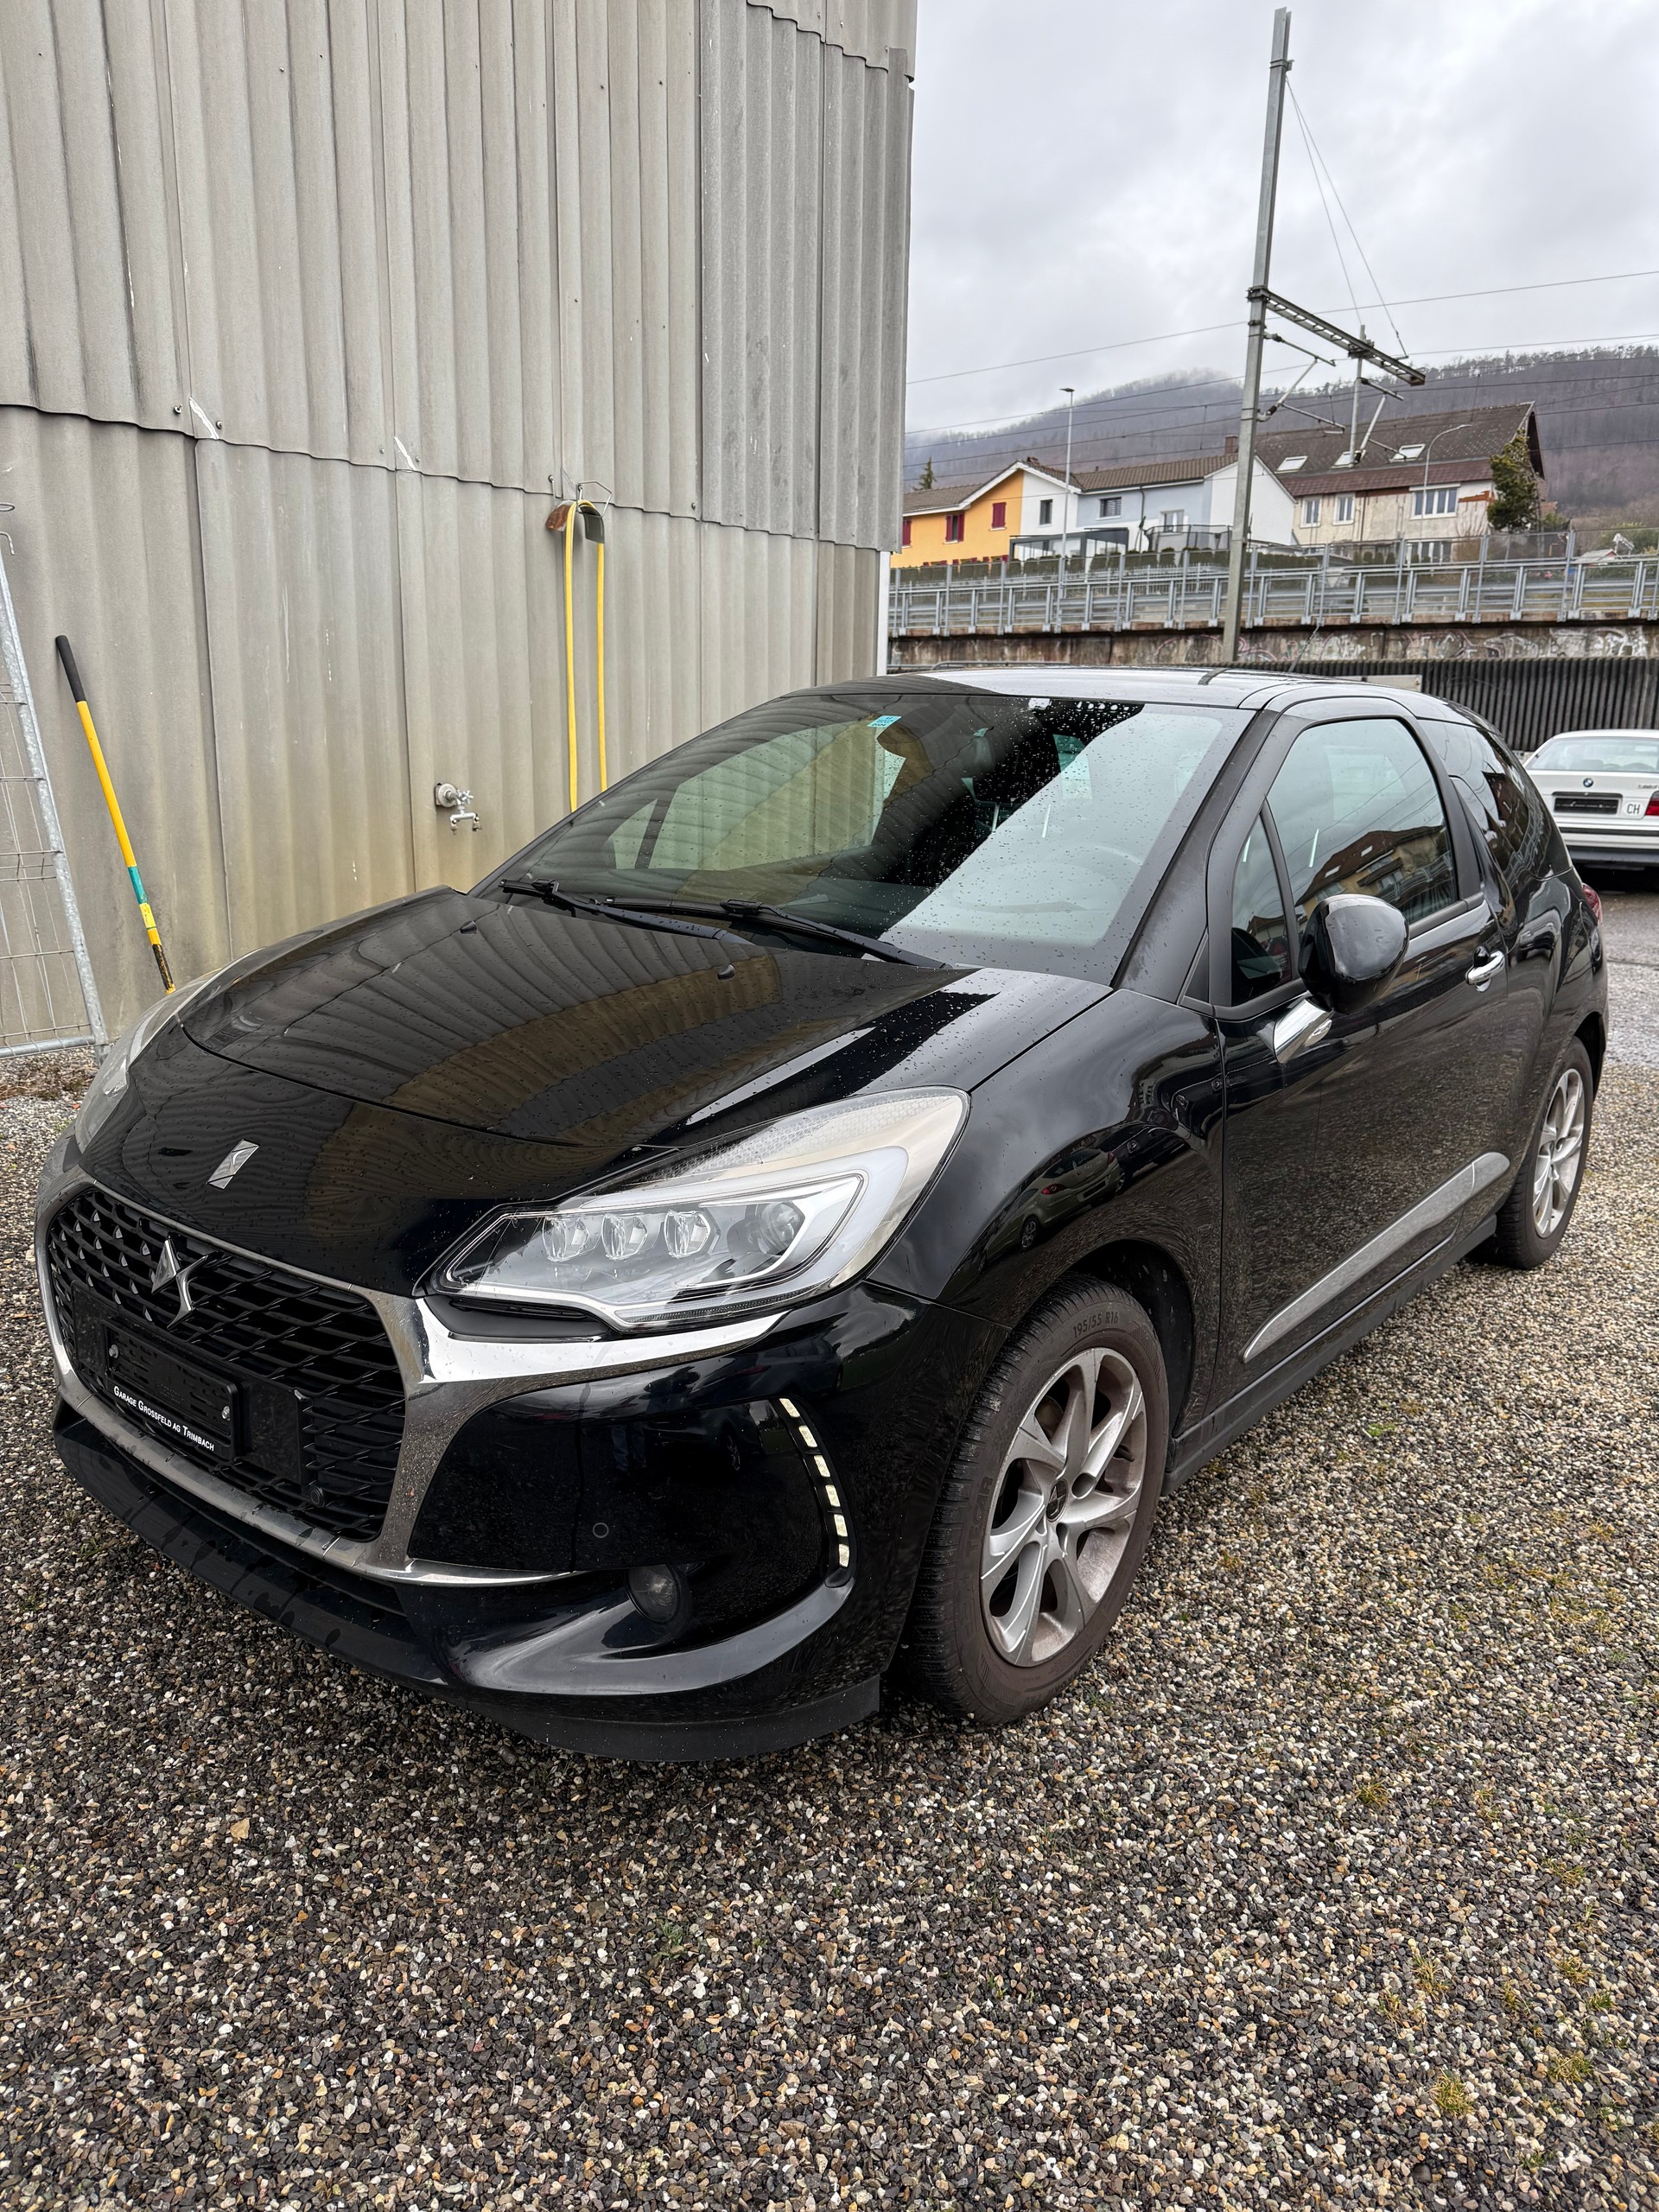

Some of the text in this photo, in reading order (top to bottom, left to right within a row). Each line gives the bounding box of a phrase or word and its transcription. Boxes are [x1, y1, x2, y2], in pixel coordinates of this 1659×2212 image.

[1626, 803, 1641, 815] CH
[1072, 1311, 1119, 1338] 195/55 R16
[113, 1385, 137, 1408] GARAGE
[137, 1400, 172, 1427] GROSSFELD
[182, 1424, 215, 1452] TRIMBACH
